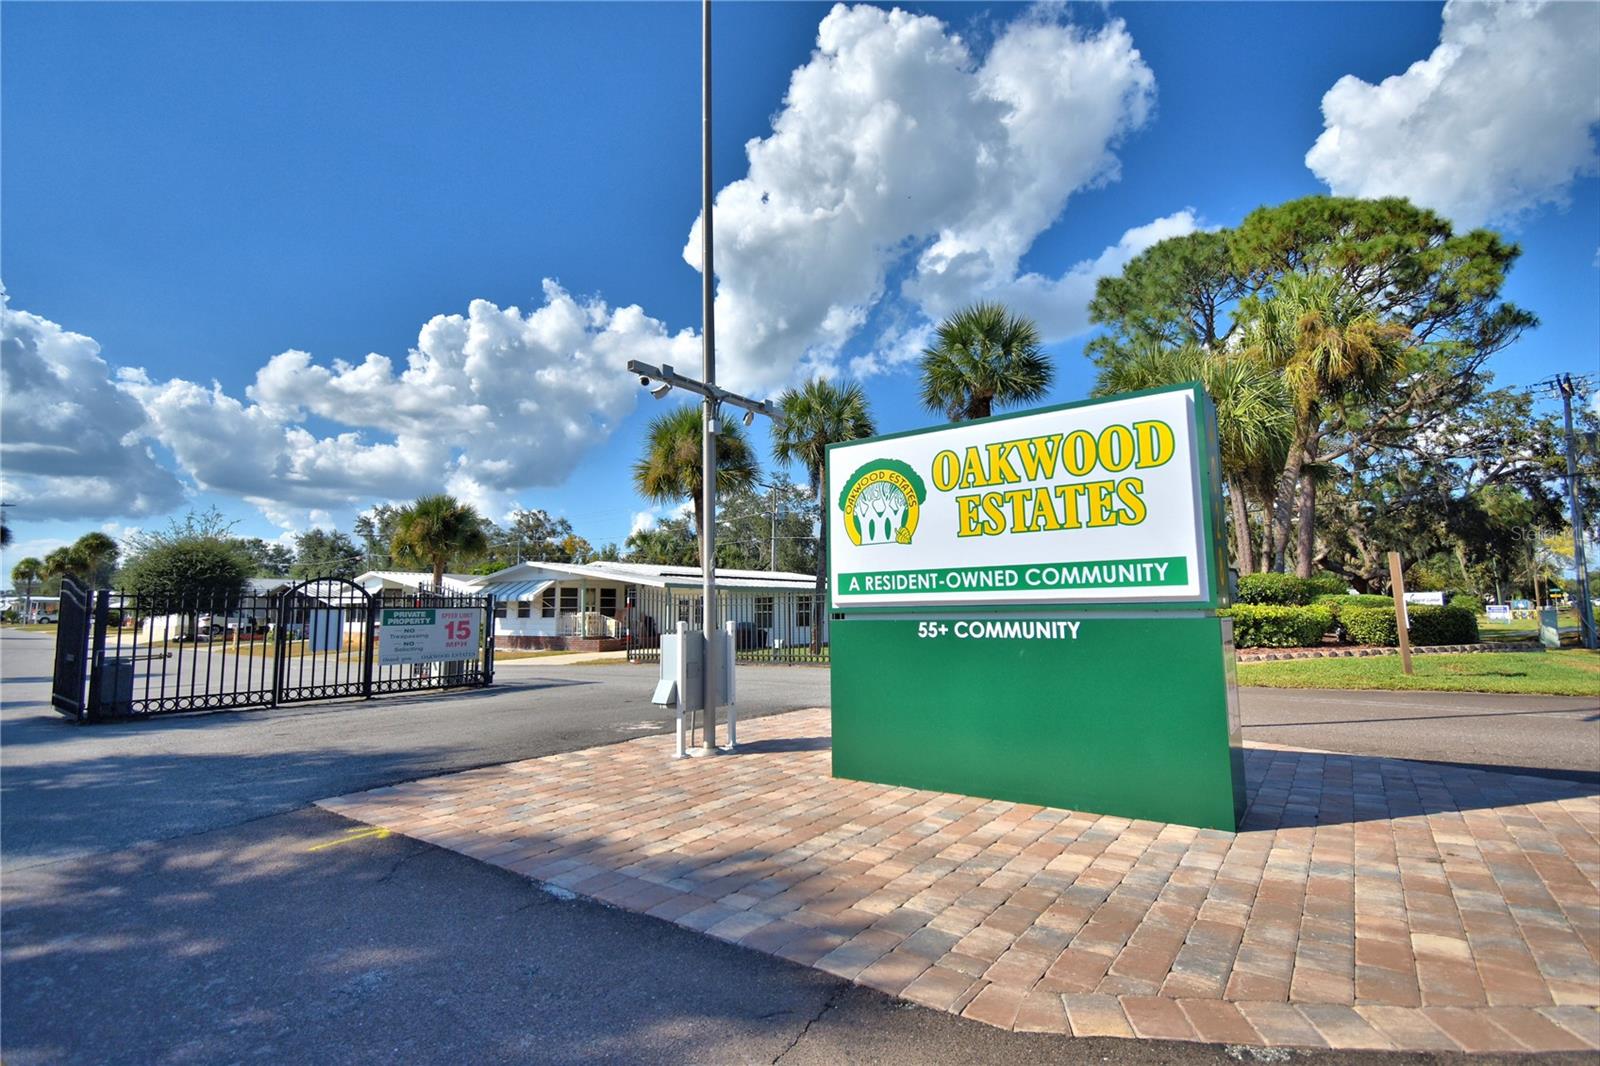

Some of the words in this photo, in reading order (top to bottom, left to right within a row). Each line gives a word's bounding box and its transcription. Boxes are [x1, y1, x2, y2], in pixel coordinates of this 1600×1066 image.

[931, 420, 1176, 492] OAKWOOD
[846, 471, 885, 515] OAKWOOD
[889, 473, 917, 508] ESTATES
[956, 477, 1147, 537] ESTATES
[848, 576, 861, 591] A
[865, 569, 1018, 591] RESIDENT-OWNED
[1025, 562, 1169, 587] COMMUNITY
[445, 621, 471, 640] 15
[917, 621, 949, 639] 55+
[954, 621, 1080, 639] COMMUNITY
